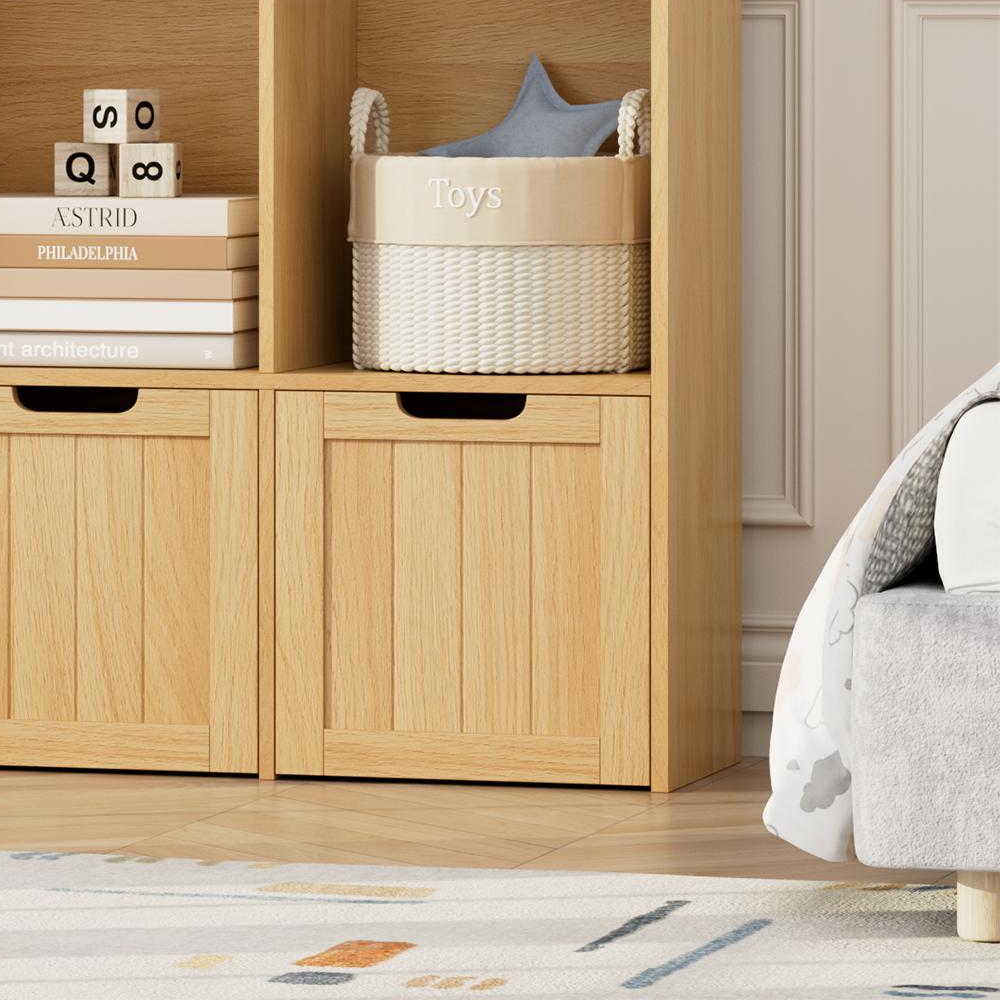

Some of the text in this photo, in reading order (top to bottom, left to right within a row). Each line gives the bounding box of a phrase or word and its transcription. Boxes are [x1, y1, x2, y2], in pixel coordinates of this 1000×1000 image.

[92, 104, 118, 129] S
[65, 151, 96, 185] Q
[131, 161, 164, 181] 8
[428, 177, 504, 219] Toys
[37, 245, 139, 261] PHILADELPHIA
[20, 340, 140, 359] architecture
